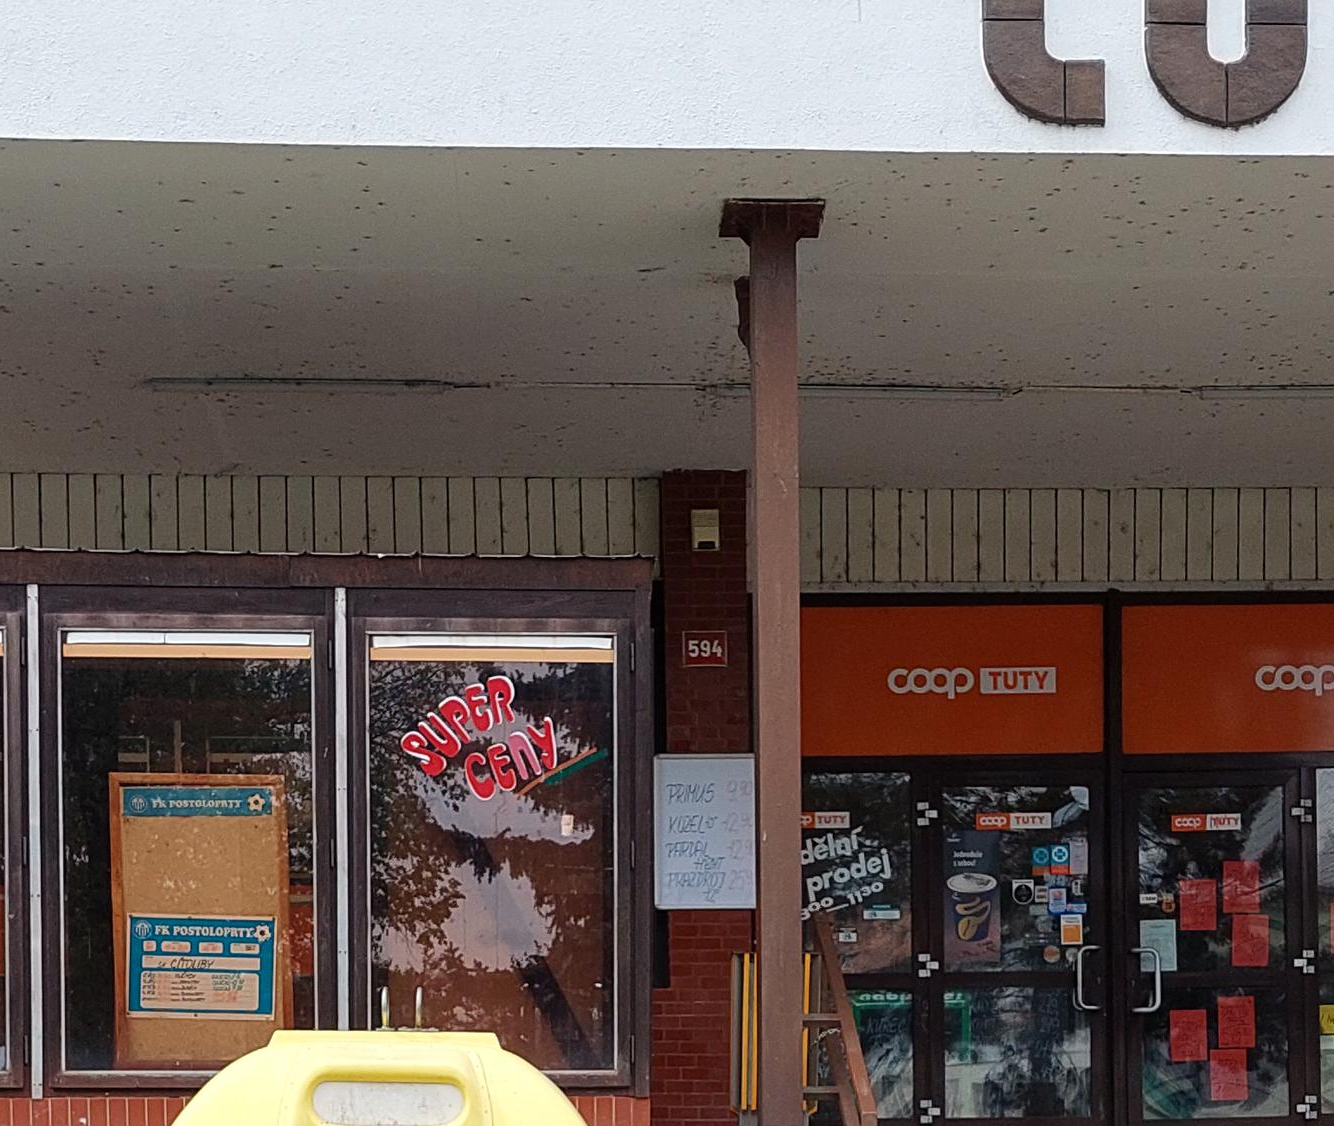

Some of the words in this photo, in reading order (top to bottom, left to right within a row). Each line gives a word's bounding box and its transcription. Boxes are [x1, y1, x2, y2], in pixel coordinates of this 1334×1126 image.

[688, 639, 723, 658] 594
[887, 667, 974, 699] coop
[988, 671, 1048, 690] TUTY
[401, 675, 515, 777] SUPER
[817, 815, 846, 824] TUTY
[1014, 815, 1045, 825] TUTY
[800, 825, 864, 865] dělní
[806, 848, 892, 902] prodej
[155, 925, 171, 936] FK
[173, 926, 255, 938] POSTOLOPRTY
